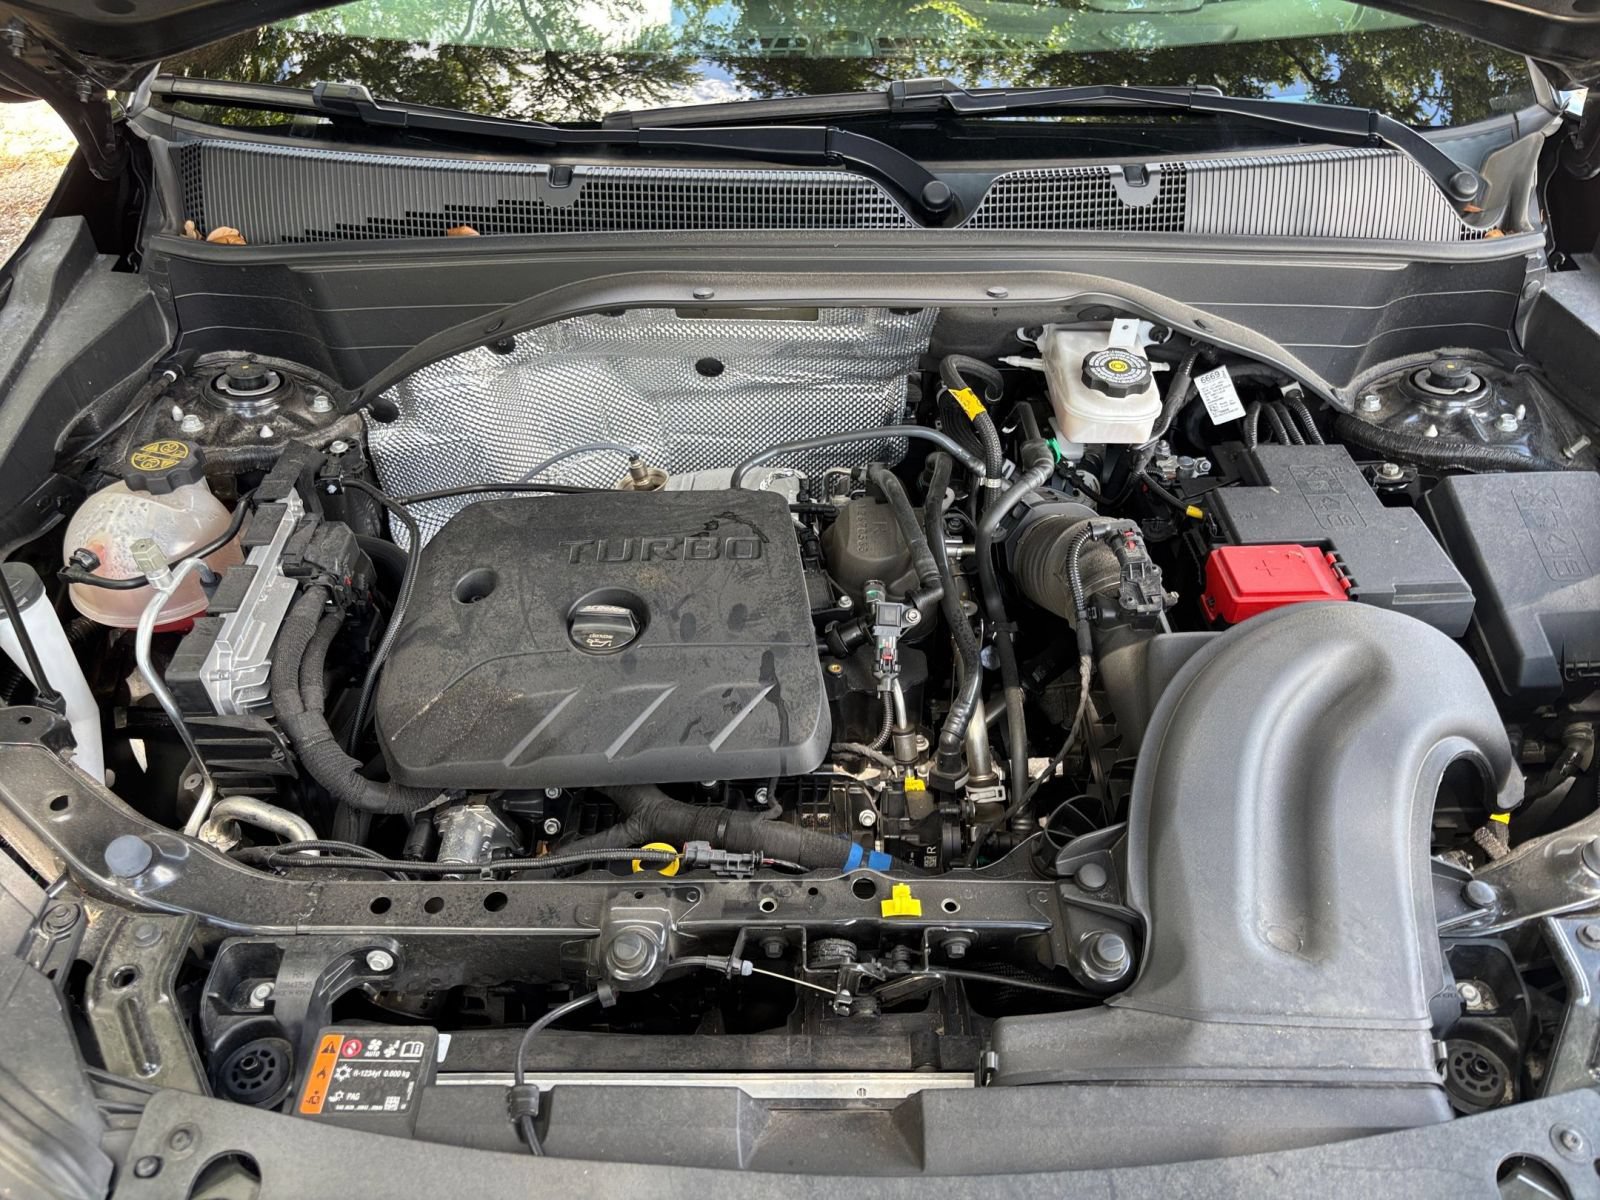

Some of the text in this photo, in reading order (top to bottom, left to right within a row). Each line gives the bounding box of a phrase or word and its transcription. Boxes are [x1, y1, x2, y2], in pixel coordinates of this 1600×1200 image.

[1200, 370, 1221, 384] 6669
[559, 536, 763, 565] TURBO
[352, 1069, 382, 1079] R-1234yf
[401, 1070, 411, 1079] kg
[346, 1092, 361, 1101] PAG
